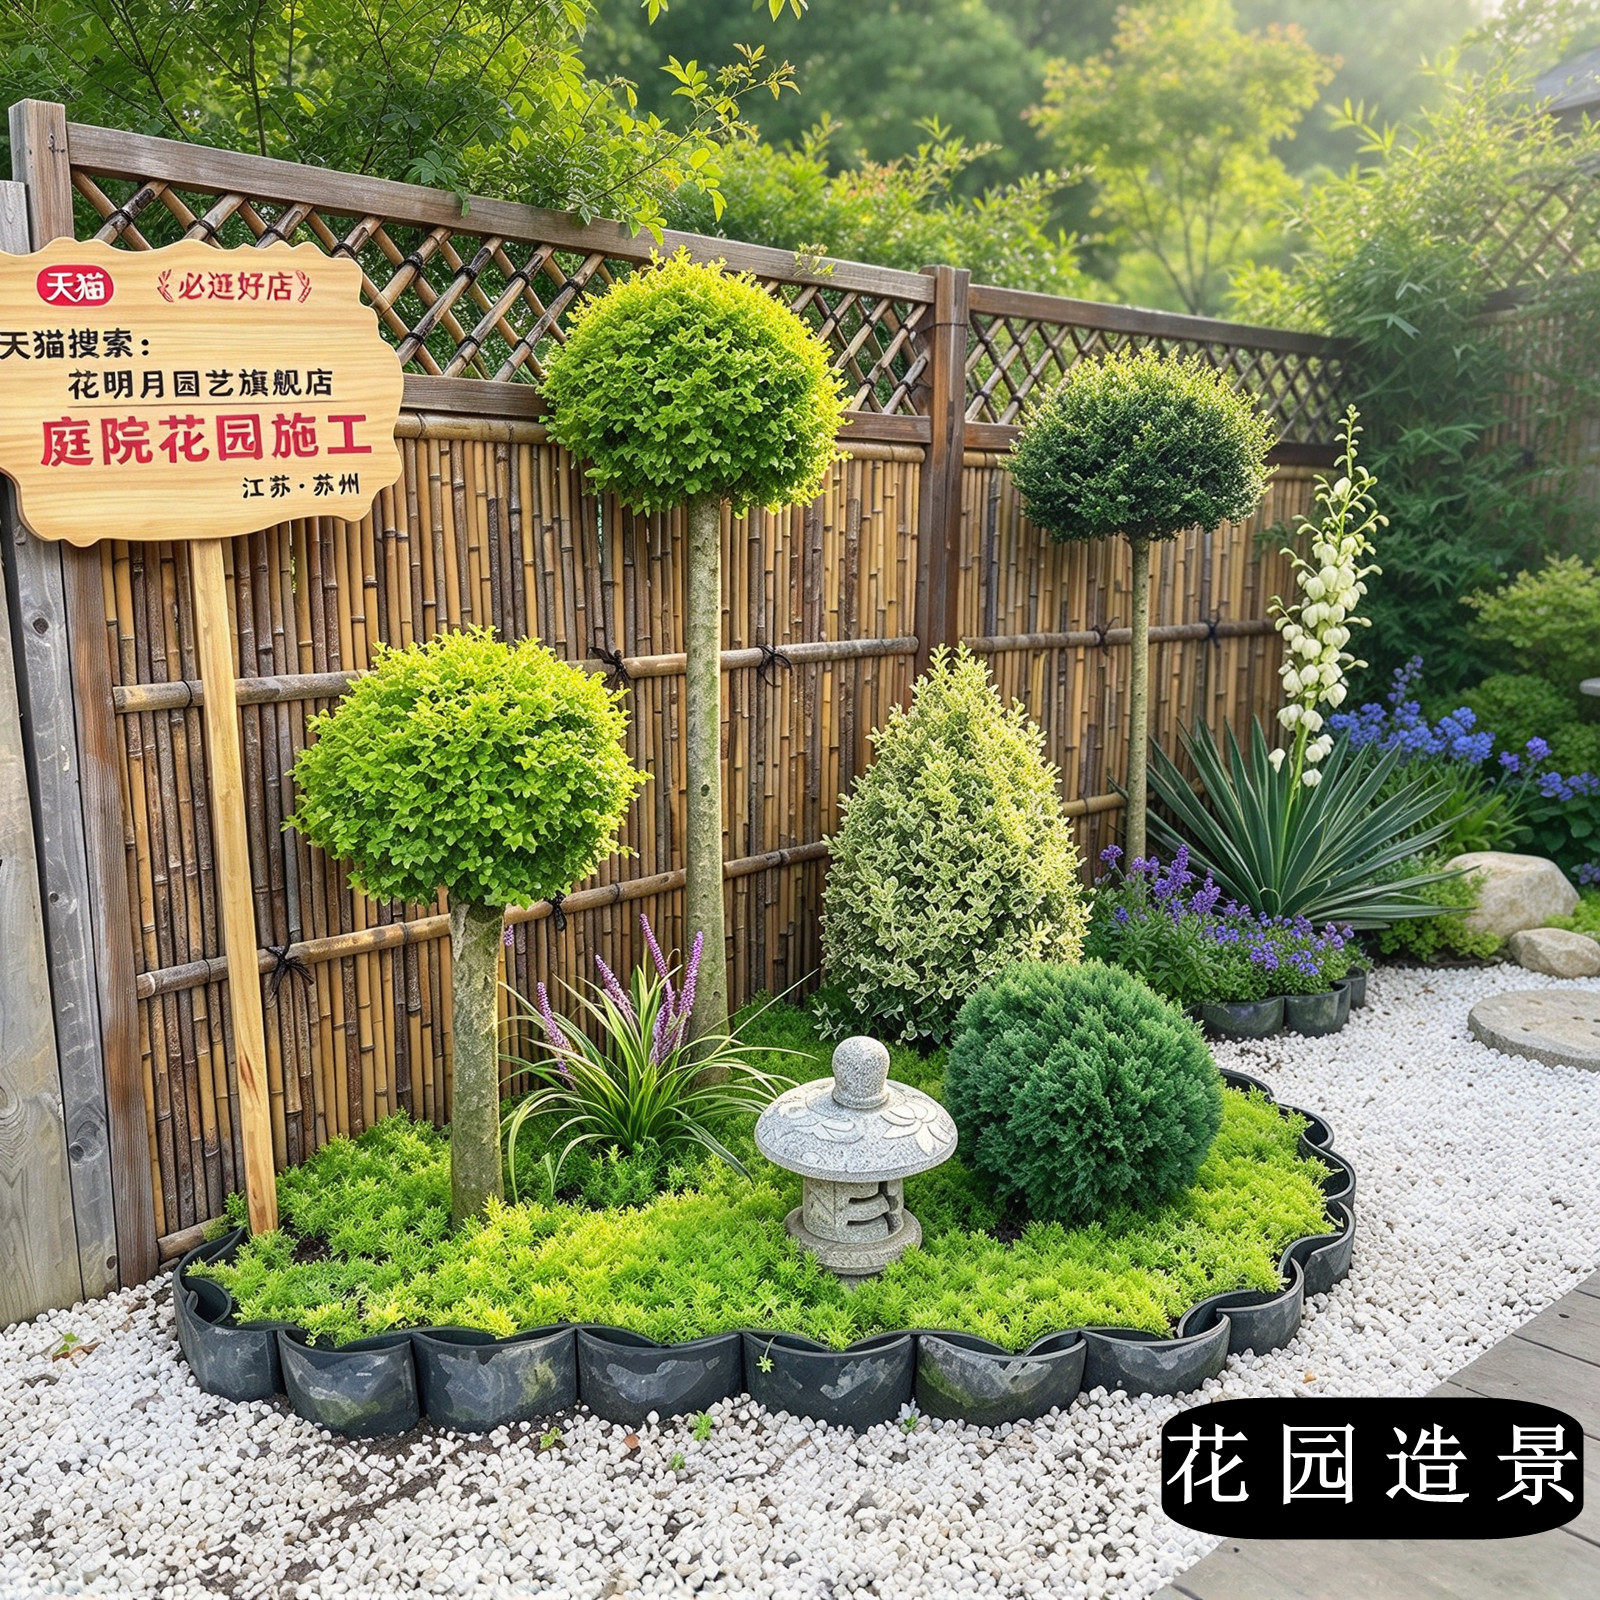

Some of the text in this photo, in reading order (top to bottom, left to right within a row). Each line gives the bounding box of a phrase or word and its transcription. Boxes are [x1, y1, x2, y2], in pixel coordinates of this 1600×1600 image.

[46, 271, 105, 303] 天猫
[178, 271, 293, 301] 必逛好店
[68, 367, 333, 400] 花明月园艺旗舰店
[40, 412, 373, 467] 庭院花园施工
